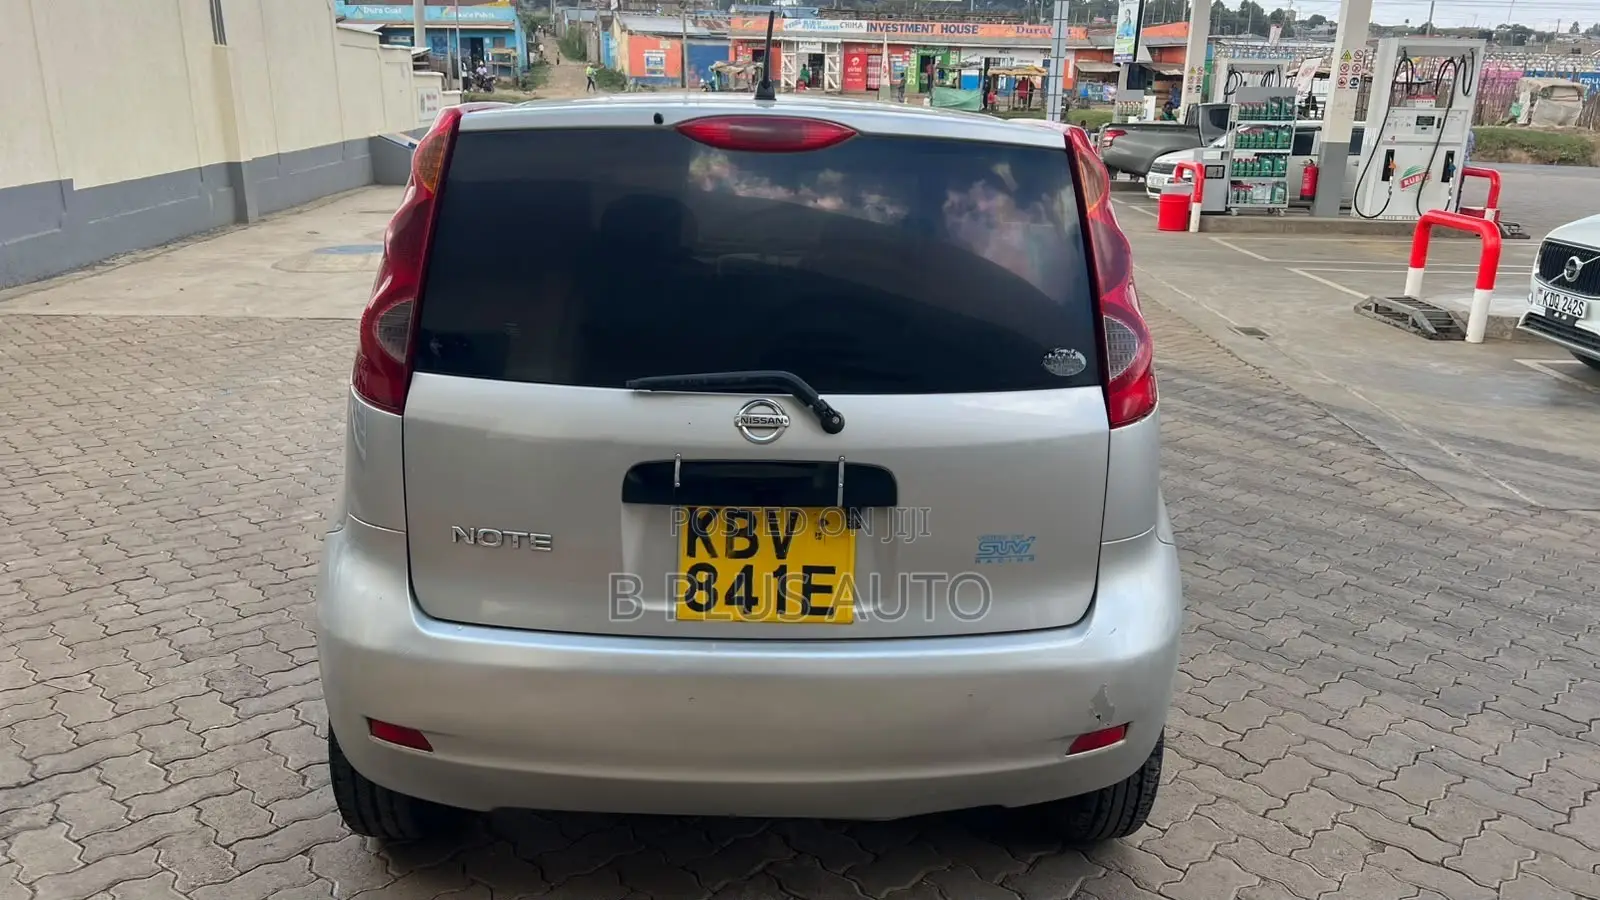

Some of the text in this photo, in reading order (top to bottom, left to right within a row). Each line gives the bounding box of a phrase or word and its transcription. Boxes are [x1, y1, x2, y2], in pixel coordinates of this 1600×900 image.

[866, 22, 936, 33] INVESTMENT
[940, 24, 979, 34] HOUSE
[1403, 173, 1428, 186] RUBI
[1542, 291, 1584, 316] KDQ 242S
[740, 417, 784, 425] NISSAN
[451, 525, 553, 552] NOTE
[686, 507, 798, 559] KBV
[685, 563, 837, 617] 841E
